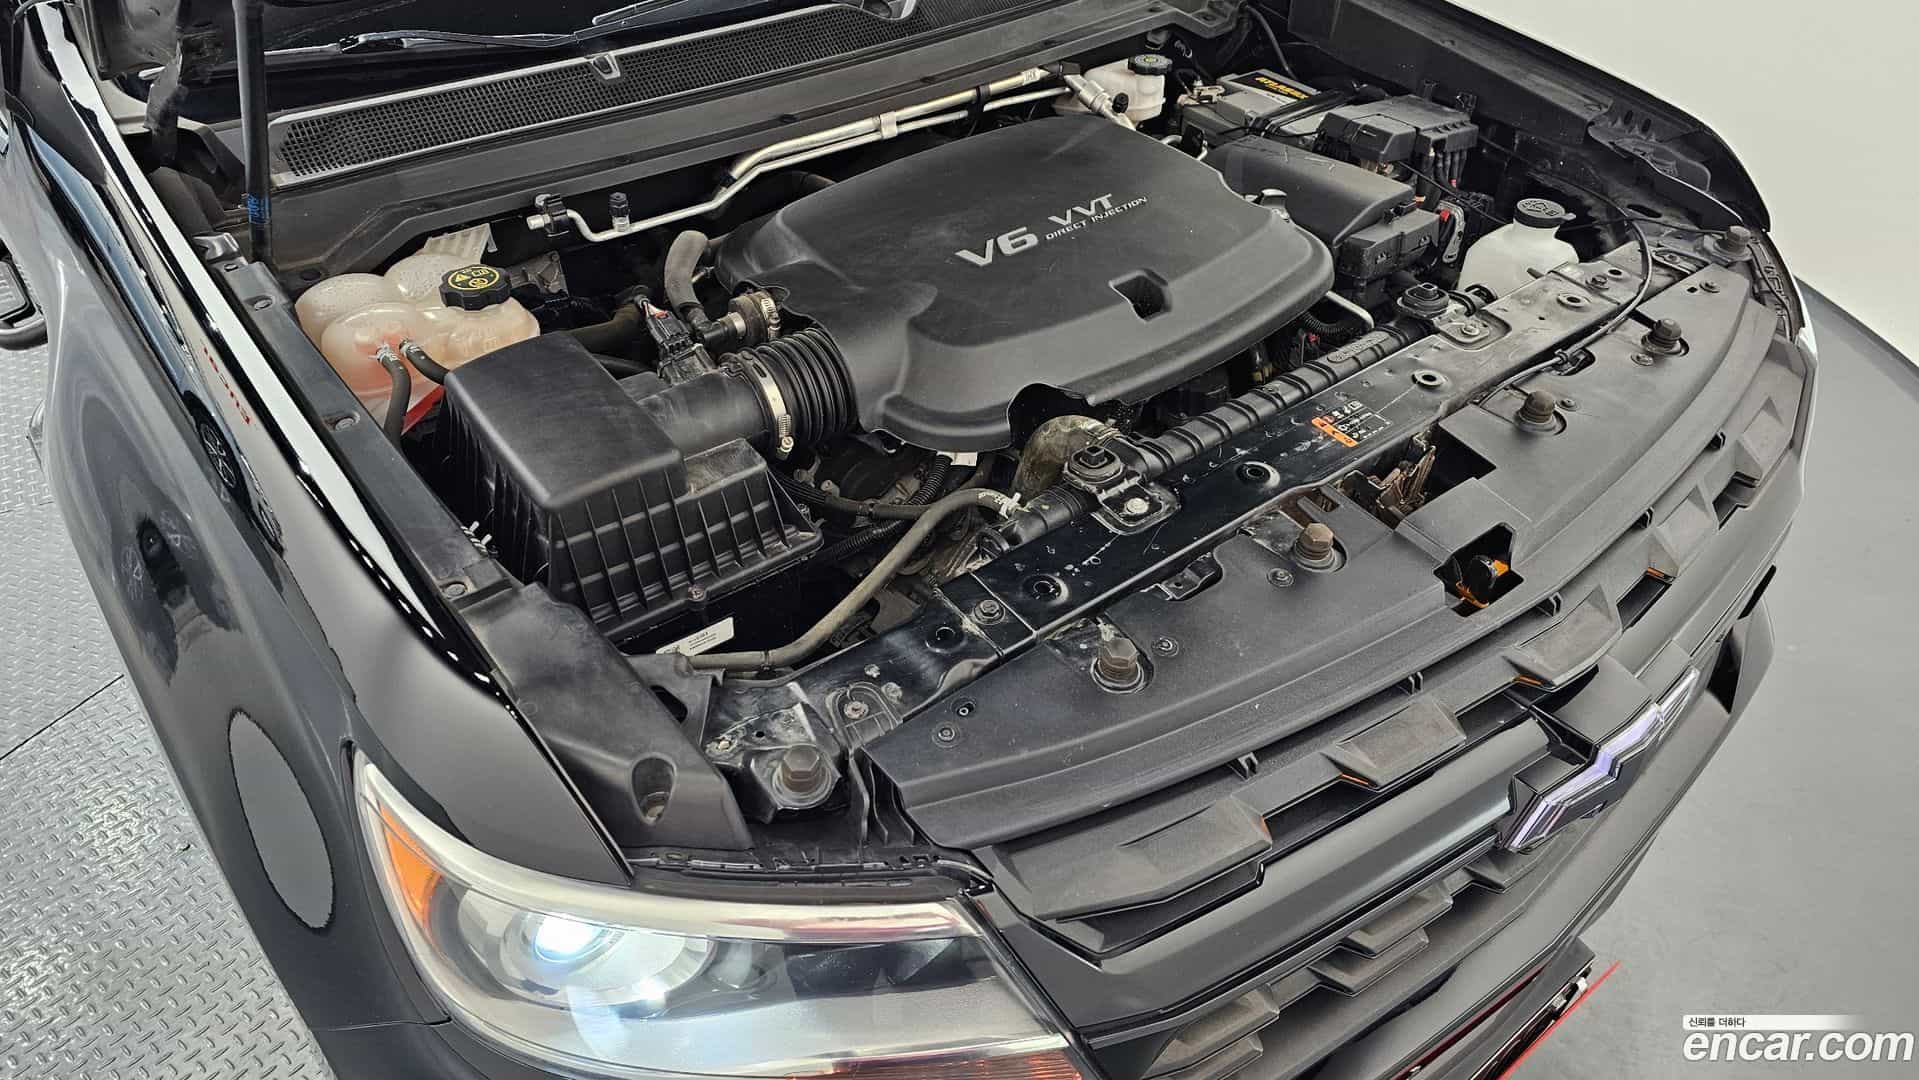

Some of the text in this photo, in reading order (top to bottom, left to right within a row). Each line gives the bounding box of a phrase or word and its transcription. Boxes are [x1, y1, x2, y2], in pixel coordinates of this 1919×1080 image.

[1045, 196, 1148, 240] DIRECT INJECTION
[1048, 193, 1112, 226] VVT
[954, 226, 1039, 267] V6
